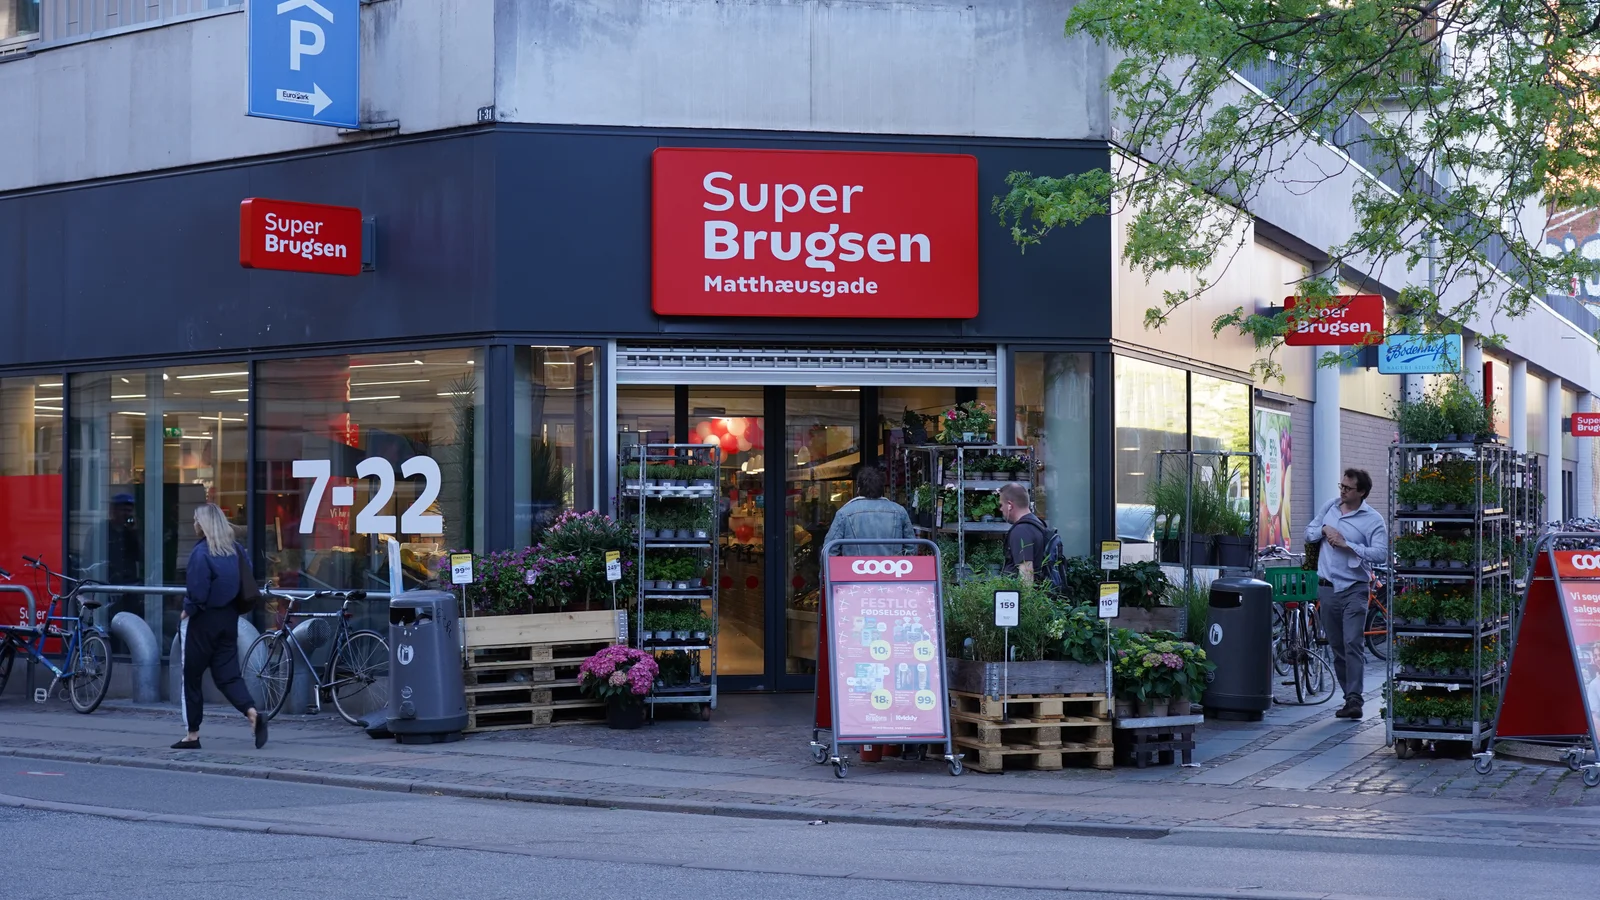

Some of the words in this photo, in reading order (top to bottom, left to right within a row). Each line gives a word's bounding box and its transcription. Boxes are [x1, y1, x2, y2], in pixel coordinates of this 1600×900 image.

[290, 20, 325, 70] P
[479, 109, 492, 120] 1-31
[703, 171, 864, 222] Super
[265, 212, 323, 237] Super
[265, 233, 346, 260] Brugsen
[704, 220, 931, 272] Brugsen
[704, 275, 878, 297] Matthæusgade
[1300, 306, 1349, 319] per
[1297, 320, 1371, 336] Brugsen
[1577, 416, 1600, 425] Supe
[292, 455, 443, 534] 7-22
[852, 560, 913, 577] coop
[861, 597, 918, 609] FESTLIG
[1570, 592, 1580, 600] Vi
[20, 606, 46, 620] Suer
